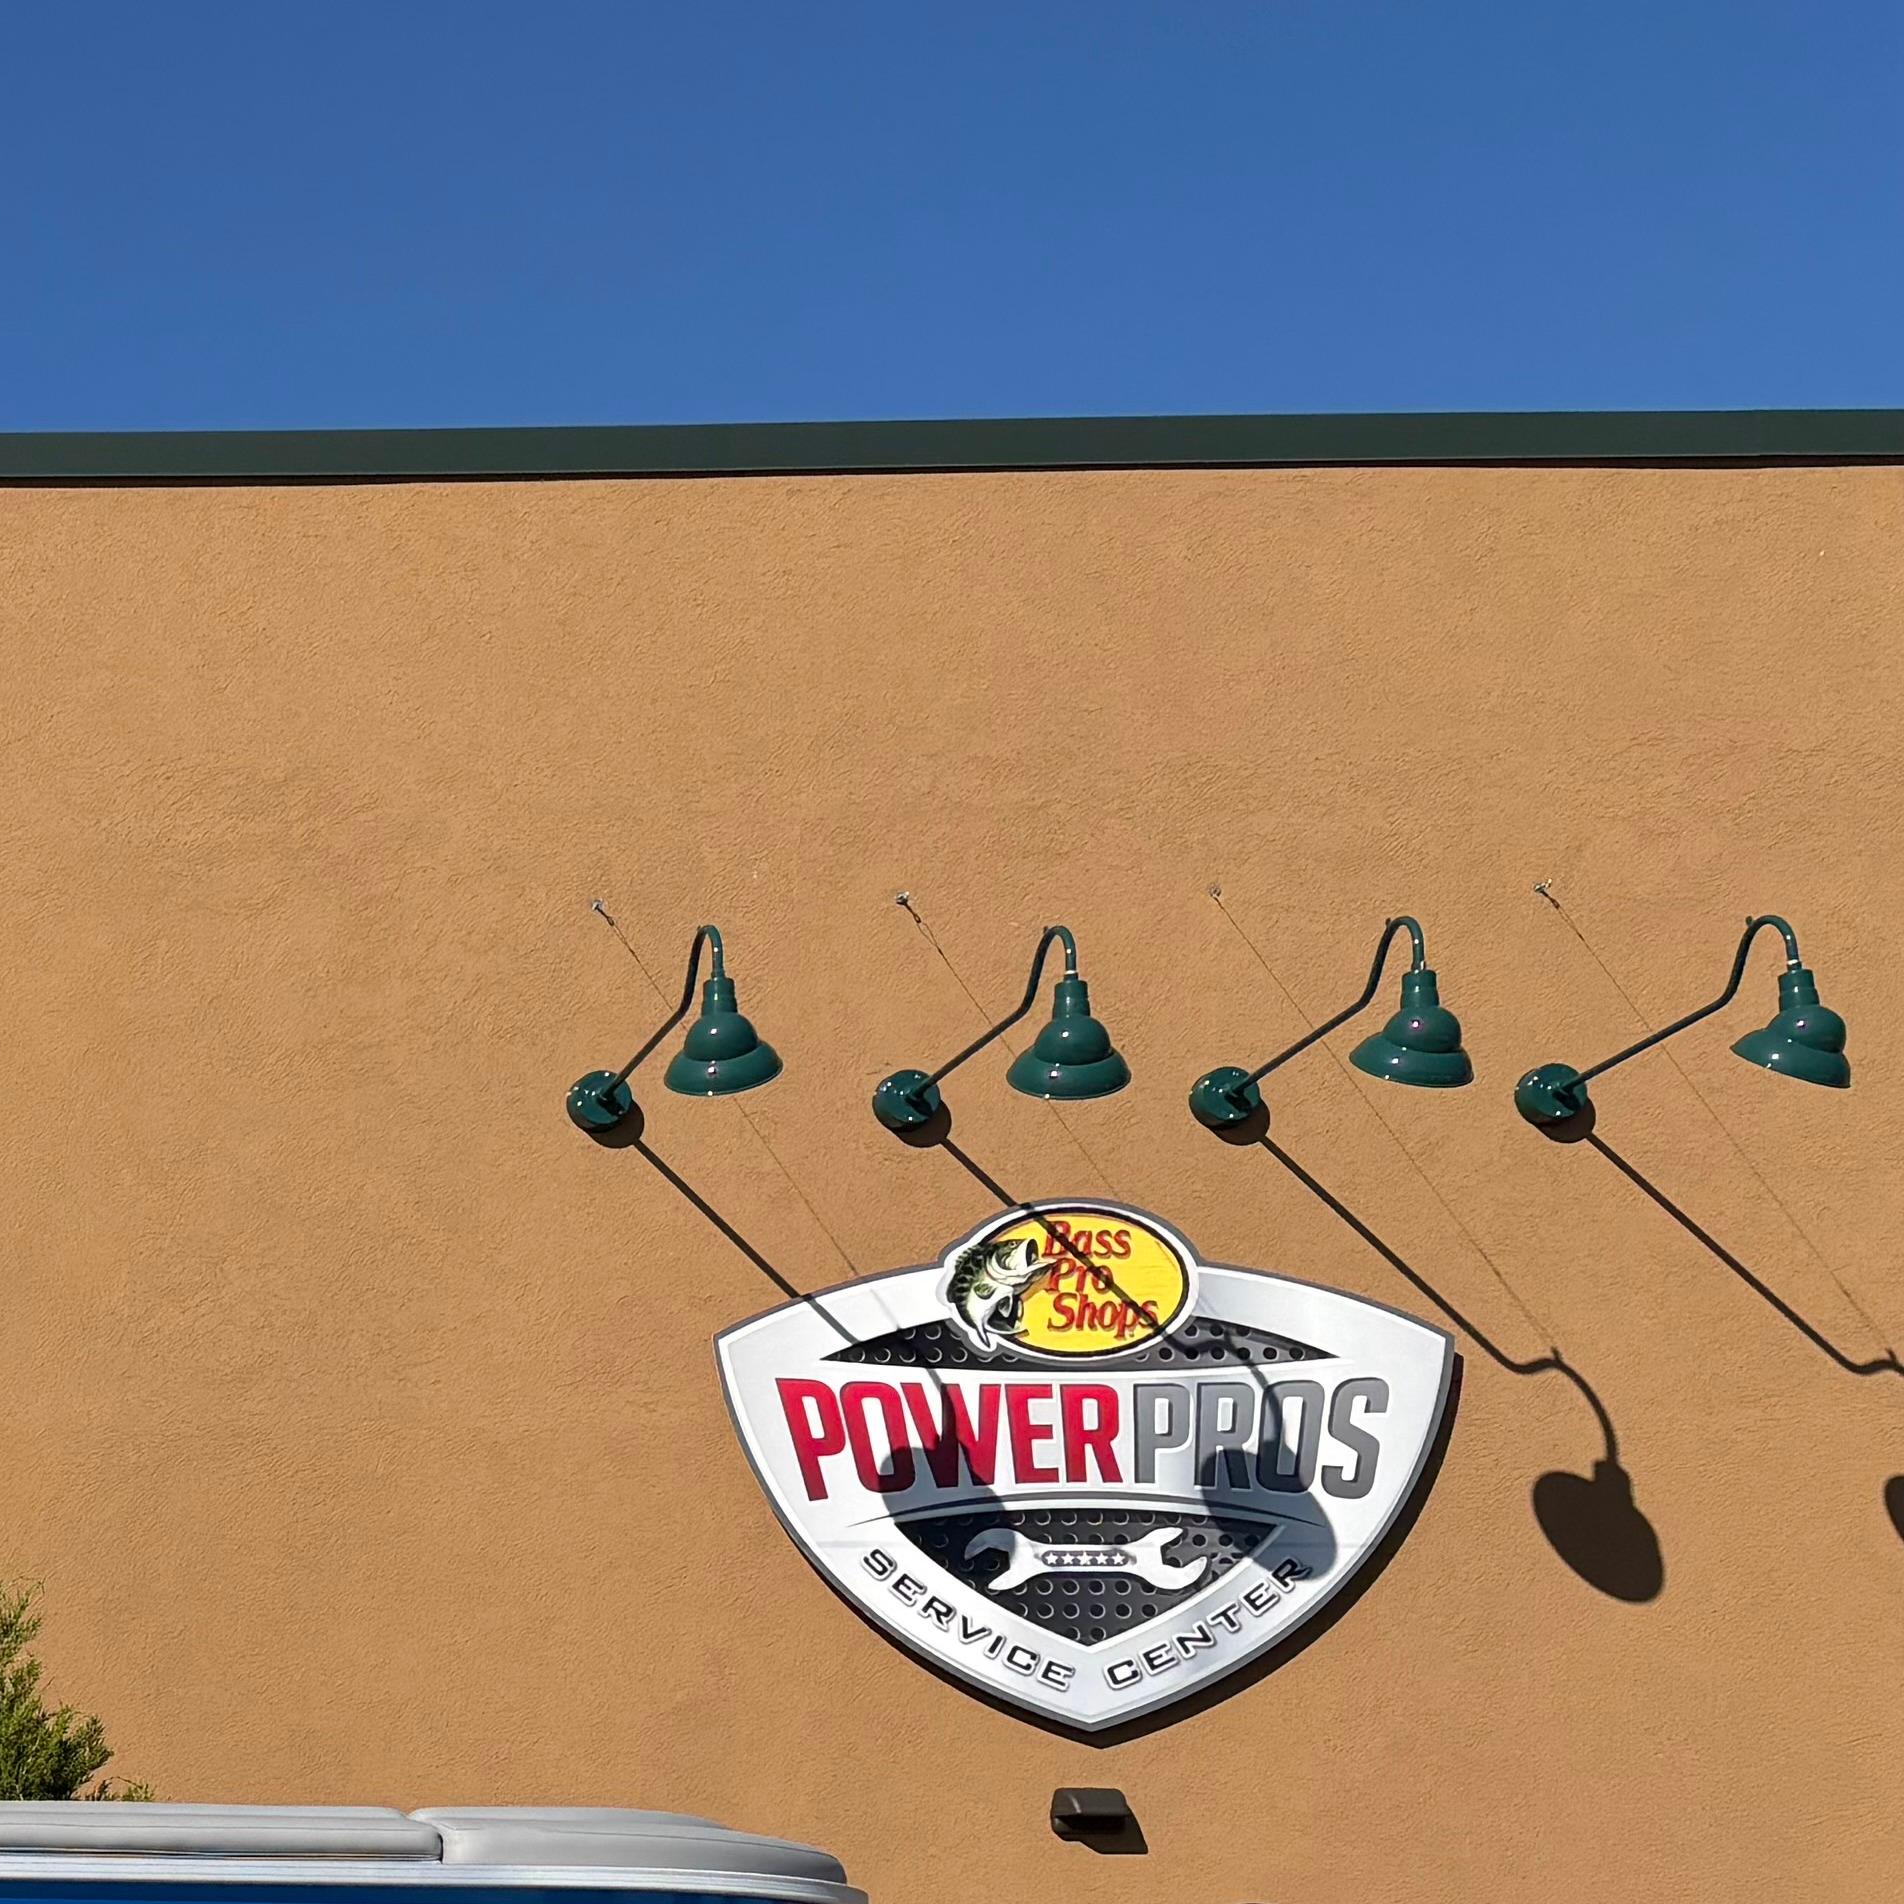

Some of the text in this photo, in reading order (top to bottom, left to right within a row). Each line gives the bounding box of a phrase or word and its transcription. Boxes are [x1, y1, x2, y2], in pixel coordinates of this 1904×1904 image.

[1042, 1221, 1132, 1258] Bass
[1045, 1258, 1114, 1293] Pro
[1047, 1292, 1159, 1340] Shops
[861, 1548, 1313, 1690] SERVICE CENTER
